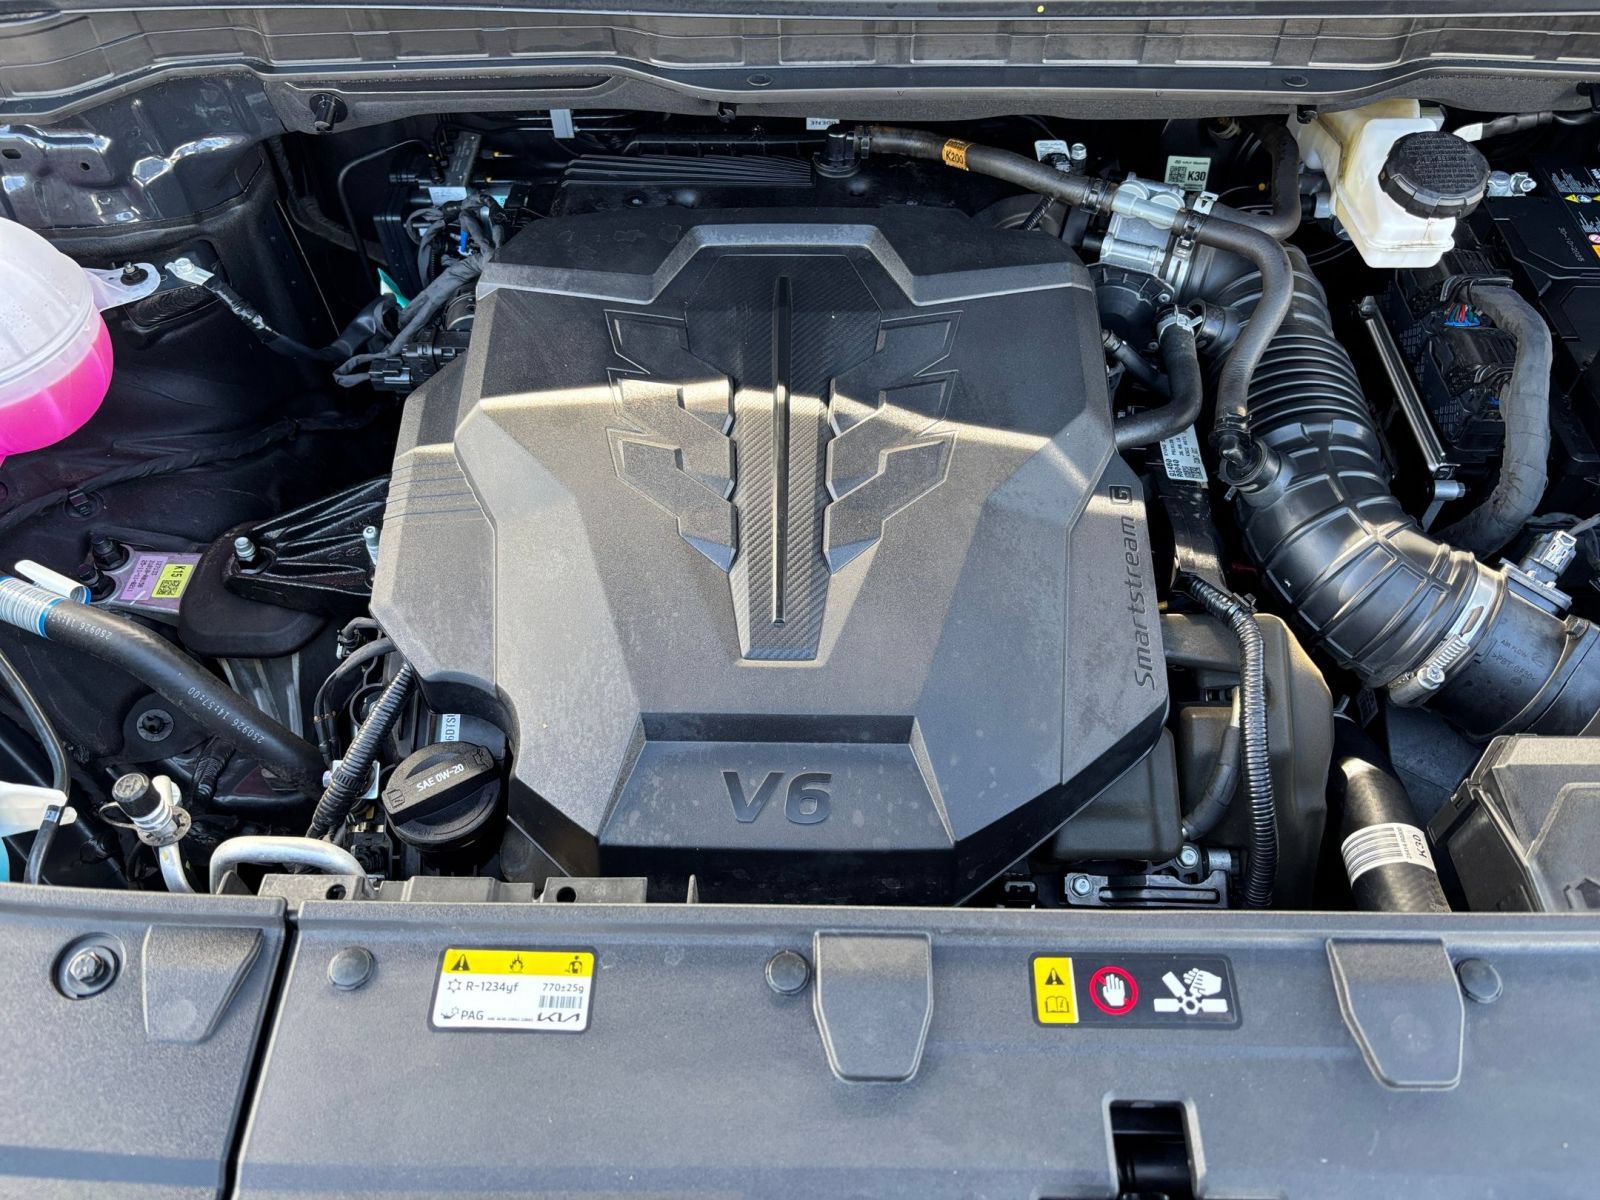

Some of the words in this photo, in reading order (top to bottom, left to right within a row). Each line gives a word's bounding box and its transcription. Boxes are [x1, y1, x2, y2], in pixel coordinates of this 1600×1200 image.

[945, 150, 965, 165] K200
[1187, 170, 1207, 182] K30
[170, 565, 187, 578] K15
[1121, 515, 1156, 691] Smartstream
[79, 621, 113, 640] 250926
[187, 686, 230, 720] 14:57:00
[231, 718, 265, 744] 250926
[416, 778, 436, 793] SAE
[436, 763, 466, 783] 0W-20
[720, 770, 833, 825] V6
[1412, 834, 1427, 858] K30
[466, 981, 519, 995] R-1234yf
[542, 983, 585, 994] 770±25g
[460, 1010, 484, 1021] PAG
[537, 1012, 581, 1023] KIA
